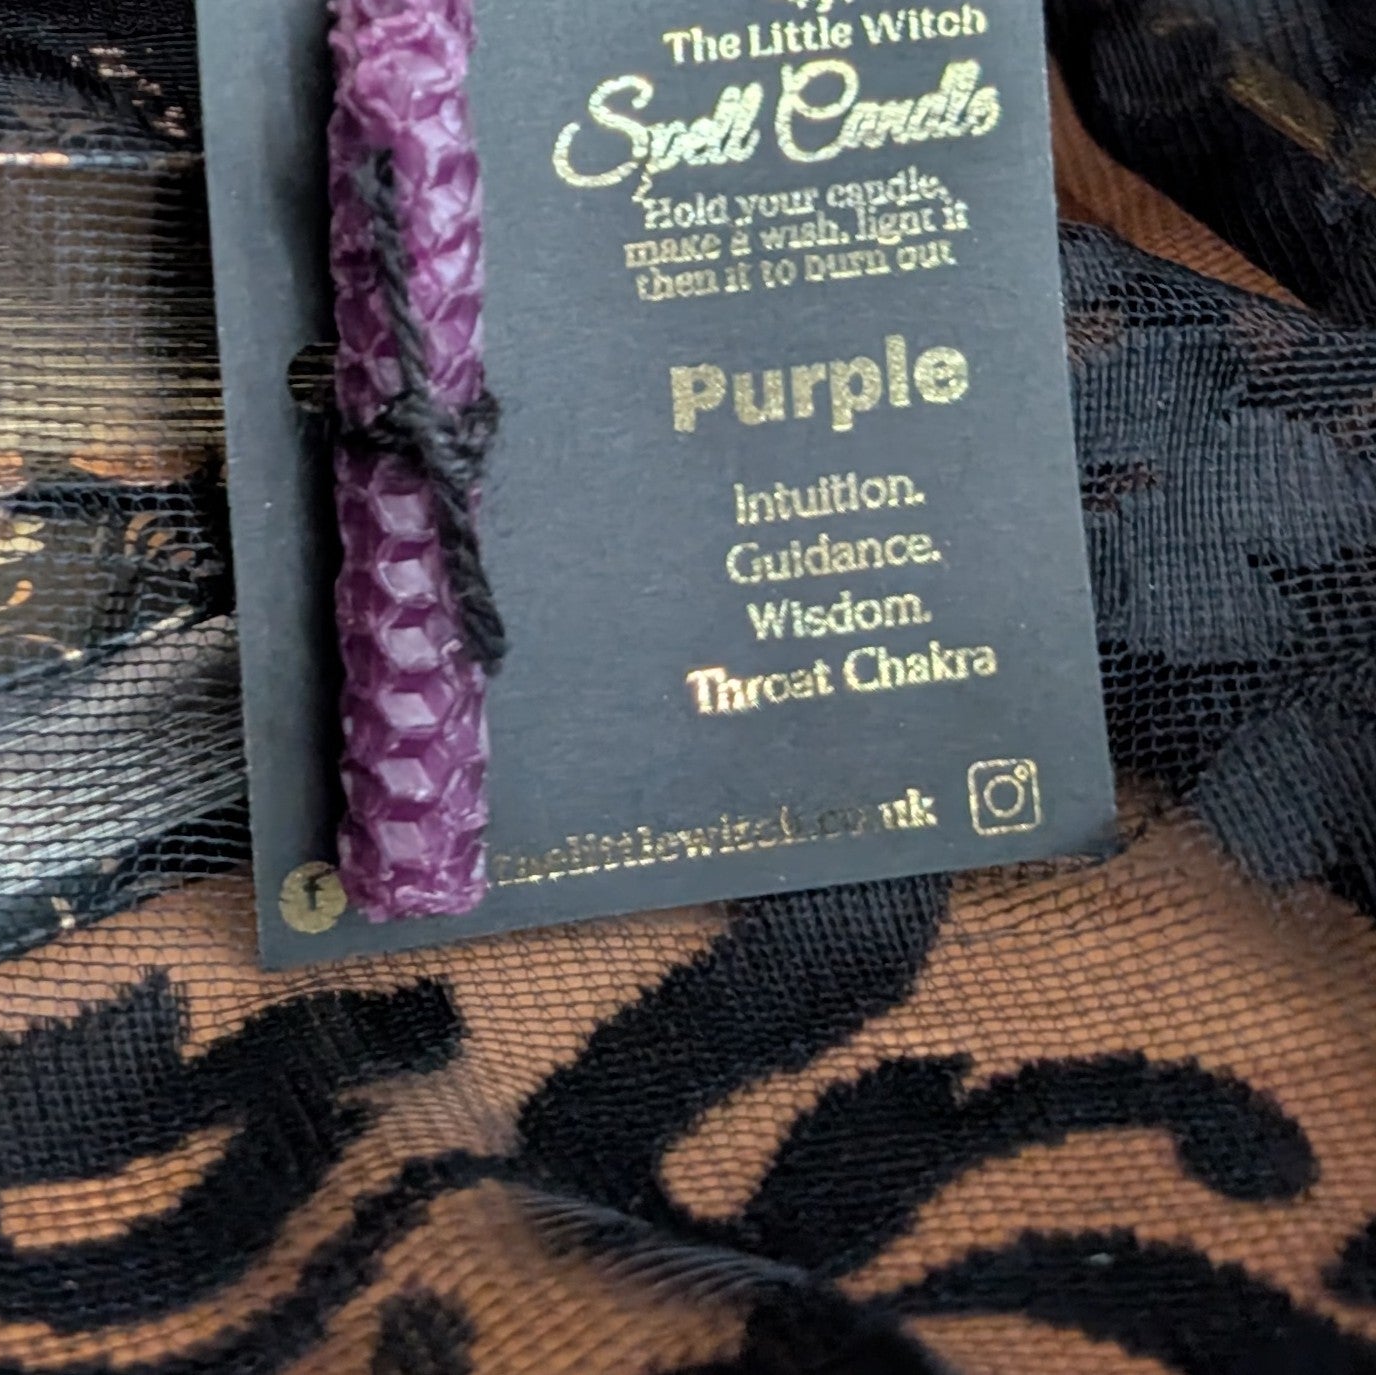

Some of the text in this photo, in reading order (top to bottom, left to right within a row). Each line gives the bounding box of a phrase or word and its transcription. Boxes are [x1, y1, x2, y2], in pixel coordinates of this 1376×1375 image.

[662, 4, 988, 64] The Little Witch
[553, 58, 1002, 204] Spell Candle
[624, 233, 721, 268] make
[730, 230, 752, 256] a
[854, 205, 937, 246] light
[942, 199, 969, 231] it
[643, 192, 730, 230] Hold
[734, 187, 820, 226] your
[635, 239, 958, 302] then it to burn out
[670, 334, 970, 432] Purple
[685, 639, 998, 715] Throat Chakra
